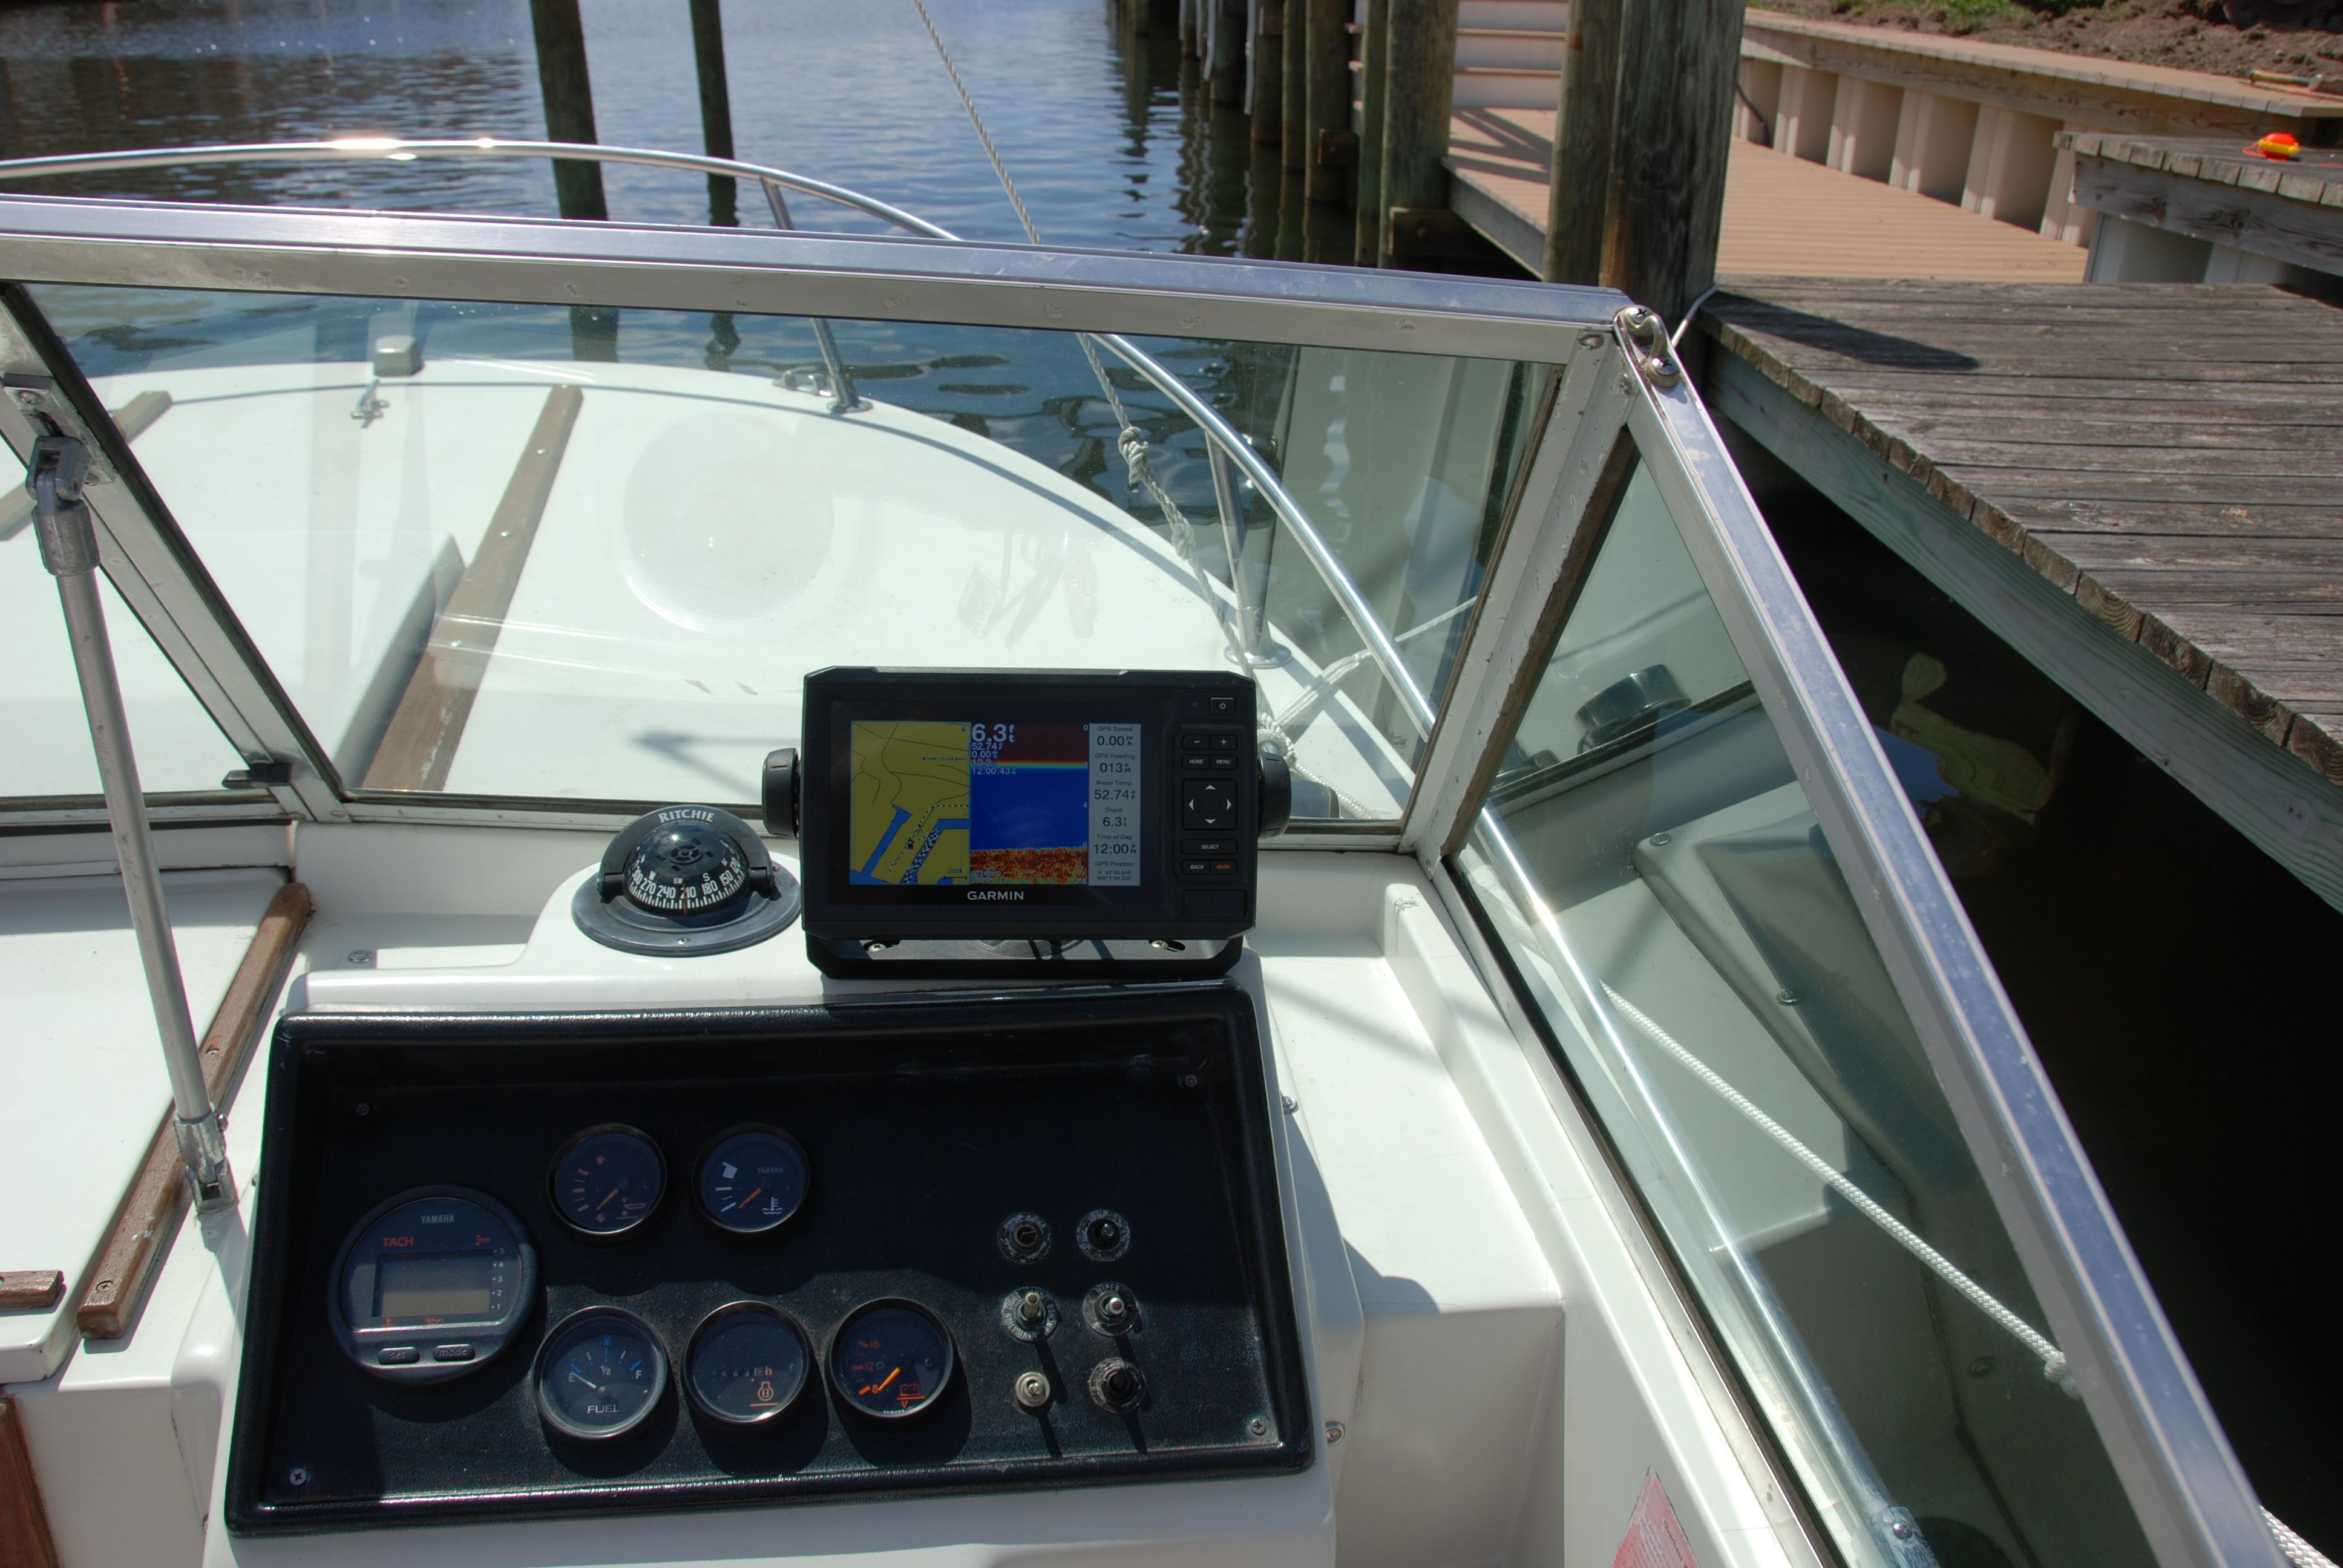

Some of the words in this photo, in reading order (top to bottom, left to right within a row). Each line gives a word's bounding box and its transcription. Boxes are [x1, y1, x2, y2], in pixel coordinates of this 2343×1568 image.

[972, 723, 1007, 742] 6.3
[1097, 736, 1124, 746] 0.00
[1099, 762, 1123, 773] 013
[1093, 789, 1130, 800] 52.74
[658, 809, 715, 823] RITCHIE
[1103, 817, 1122, 827] 6.3
[1094, 843, 1129, 854] 12:00
[649, 870, 657, 881] W
[703, 872, 710, 882] S
[719, 870, 734, 886] 150
[640, 878, 657, 895] 270
[656, 885, 677, 899] 240
[701, 880, 718, 895] 180
[680, 886, 696, 899] 210
[967, 890, 1024, 901] GARMIN
[421, 1214, 454, 1224] YAMAHA
[382, 1236, 414, 1247] TACH
[1093, 1283, 1119, 1295] WIPER
[1007, 1292, 1021, 1310] LIGHT
[390, 1350, 406, 1359] set
[439, 1347, 468, 1356] mode
[635, 1370, 642, 1379] F
[871, 1384, 878, 1394] 8
[588, 1404, 621, 1414] FUEL
[901, 1400, 908, 1409] V
[1663, 1520, 1684, 1562] Overheat
